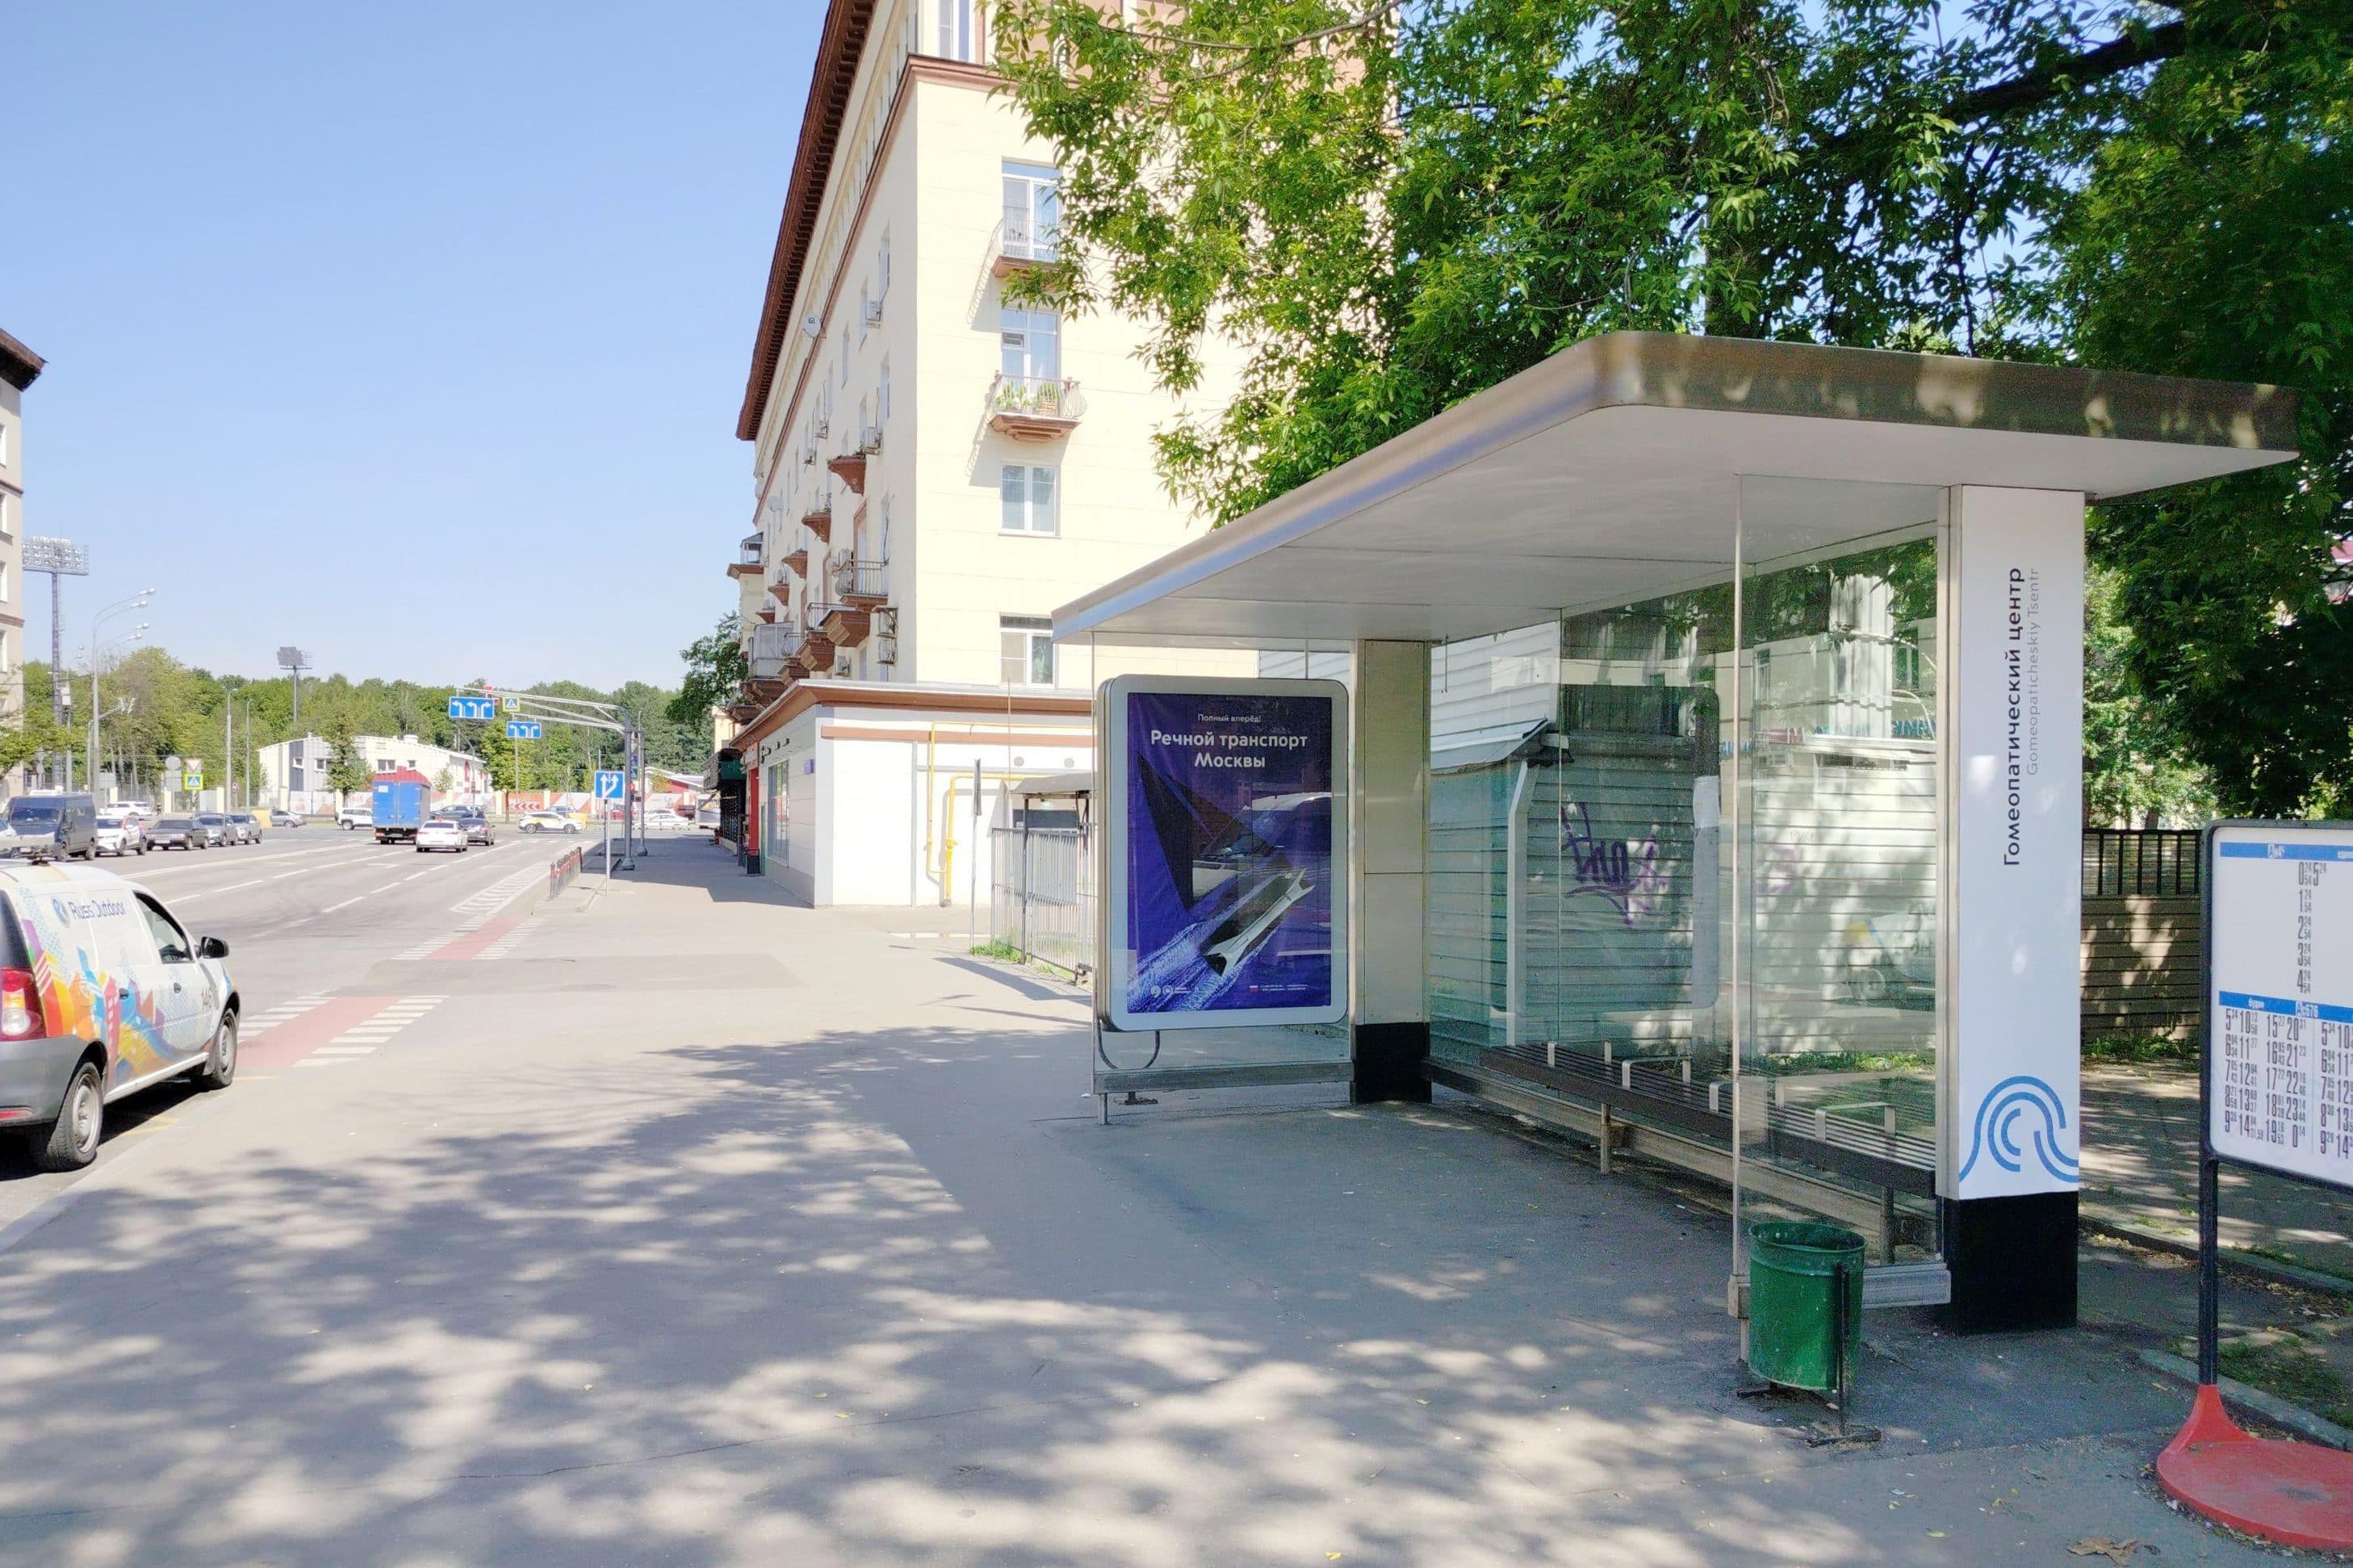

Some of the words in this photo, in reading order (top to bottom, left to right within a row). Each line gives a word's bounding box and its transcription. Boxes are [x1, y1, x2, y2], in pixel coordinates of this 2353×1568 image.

[2009, 568, 2024, 640] центр
[2027, 568, 2039, 618] Tsentr
[2027, 621, 2041, 776] Gomeopaticheskiy
[1198, 713, 1229, 722] Полный
[1231, 715, 1262, 724] вперёд!
[1150, 730, 1215, 746] Речной
[1219, 734, 1308, 751] транспорт
[1194, 752, 1266, 767] Москвы
[2003, 650, 2020, 866] Гомеопатический
[68, 901, 95, 921] Russ
[2240, 1010, 2251, 1034] 10
[2267, 1014, 2278, 1039] 15
[2287, 1017, 2299, 1042] 20
[2240, 1035, 2250, 1060] 11
[2338, 1024, 2350, 1049] 10
[2267, 1040, 2278, 1065] 16
[2287, 1043, 2298, 1068] 21
[2338, 1052, 2349, 1077] 11
[2239, 1061, 2250, 1085] 12
[2267, 1067, 2278, 1090] 17
[2287, 1070, 2299, 1095] 22
[2239, 1087, 2250, 1111] 13
[2338, 1079, 2350, 1105] 12
[2266, 1093, 2277, 1117] 18
[2286, 1097, 2299, 1122] 23
[2238, 1113, 2250, 1137] 14
[2266, 1119, 2277, 1144] 19
[2337, 1106, 2349, 1132] 13
[2337, 1134, 2349, 1160] 14
